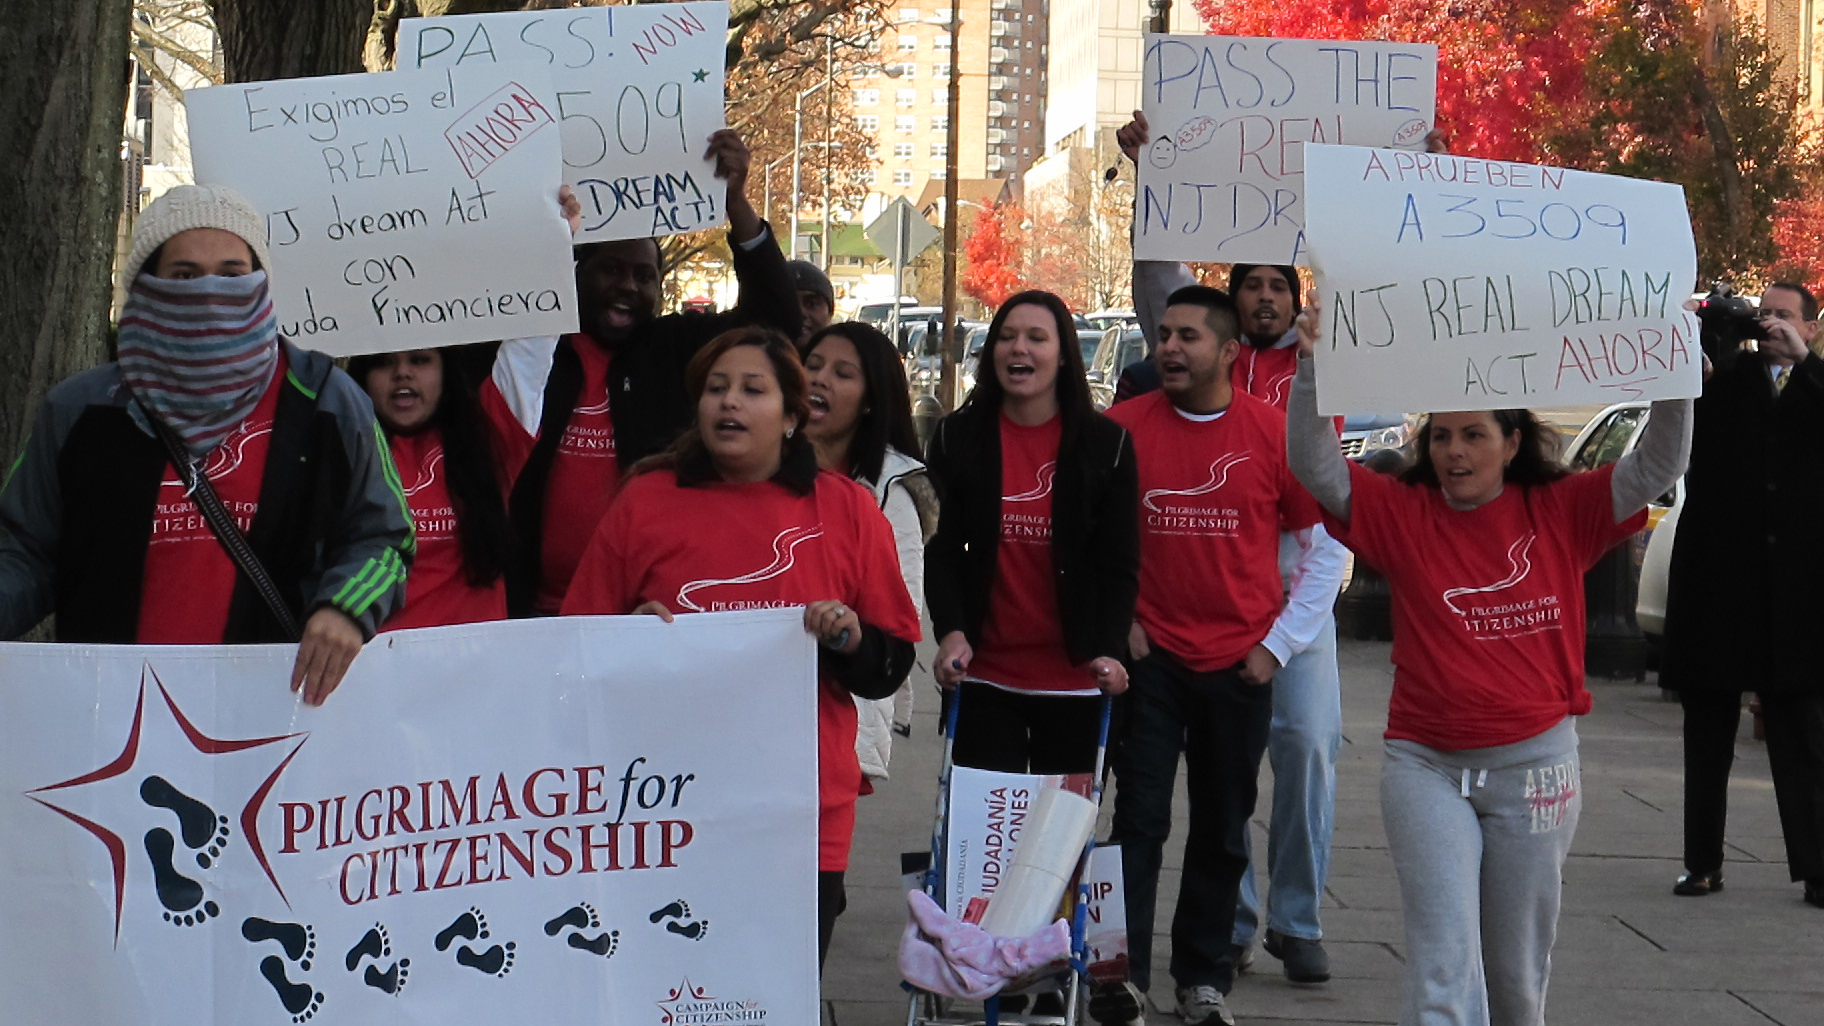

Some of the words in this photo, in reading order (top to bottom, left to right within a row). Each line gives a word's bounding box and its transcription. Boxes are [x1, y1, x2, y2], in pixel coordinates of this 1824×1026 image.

[632, 6, 706, 65] NOW
[243, 87, 409, 142] Exigimos
[431, 68, 455, 109] el
[1146, 39, 1295, 109] PASS
[1319, 48, 1423, 112] THE
[322, 135, 428, 183] REAL
[457, 92, 542, 171] AHORA
[1220, 114, 1343, 181] RE
[328, 195, 427, 242] dream
[446, 179, 496, 226] Act
[577, 170, 706, 231] DREAM
[652, 194, 715, 235] ACT!
[1143, 182, 1217, 235] NJ
[1218, 181, 1306, 251] DR
[343, 253, 415, 286] con
[275, 287, 339, 337] uda
[371, 285, 562, 326] Financiera
[1332, 283, 1398, 351] NJ
[1422, 275, 1530, 341] REAL
[1548, 267, 1671, 329] DREAM
[1465, 353, 1538, 396] ACT.
[1554, 313, 1692, 390] AHORA!
[1147, 515, 1240, 530] CITIZENSHIP
[1165, 506, 1219, 516] PILGRIMAGE
[1221, 508, 1239, 517] FOR
[1464, 608, 1561, 632] ITIZENSHIP
[1471, 600, 1536, 616] PILGRIMAGE
[277, 765, 609, 854] PILGRIMAGE
[602, 756, 696, 829] for
[340, 819, 695, 906] CITIZENSHIP
[981, 787, 1008, 893] IUDADANÍA
[675, 1001, 744, 1013] CAMPAIGN
[675, 1010, 767, 1024] CITIZENSHIP
